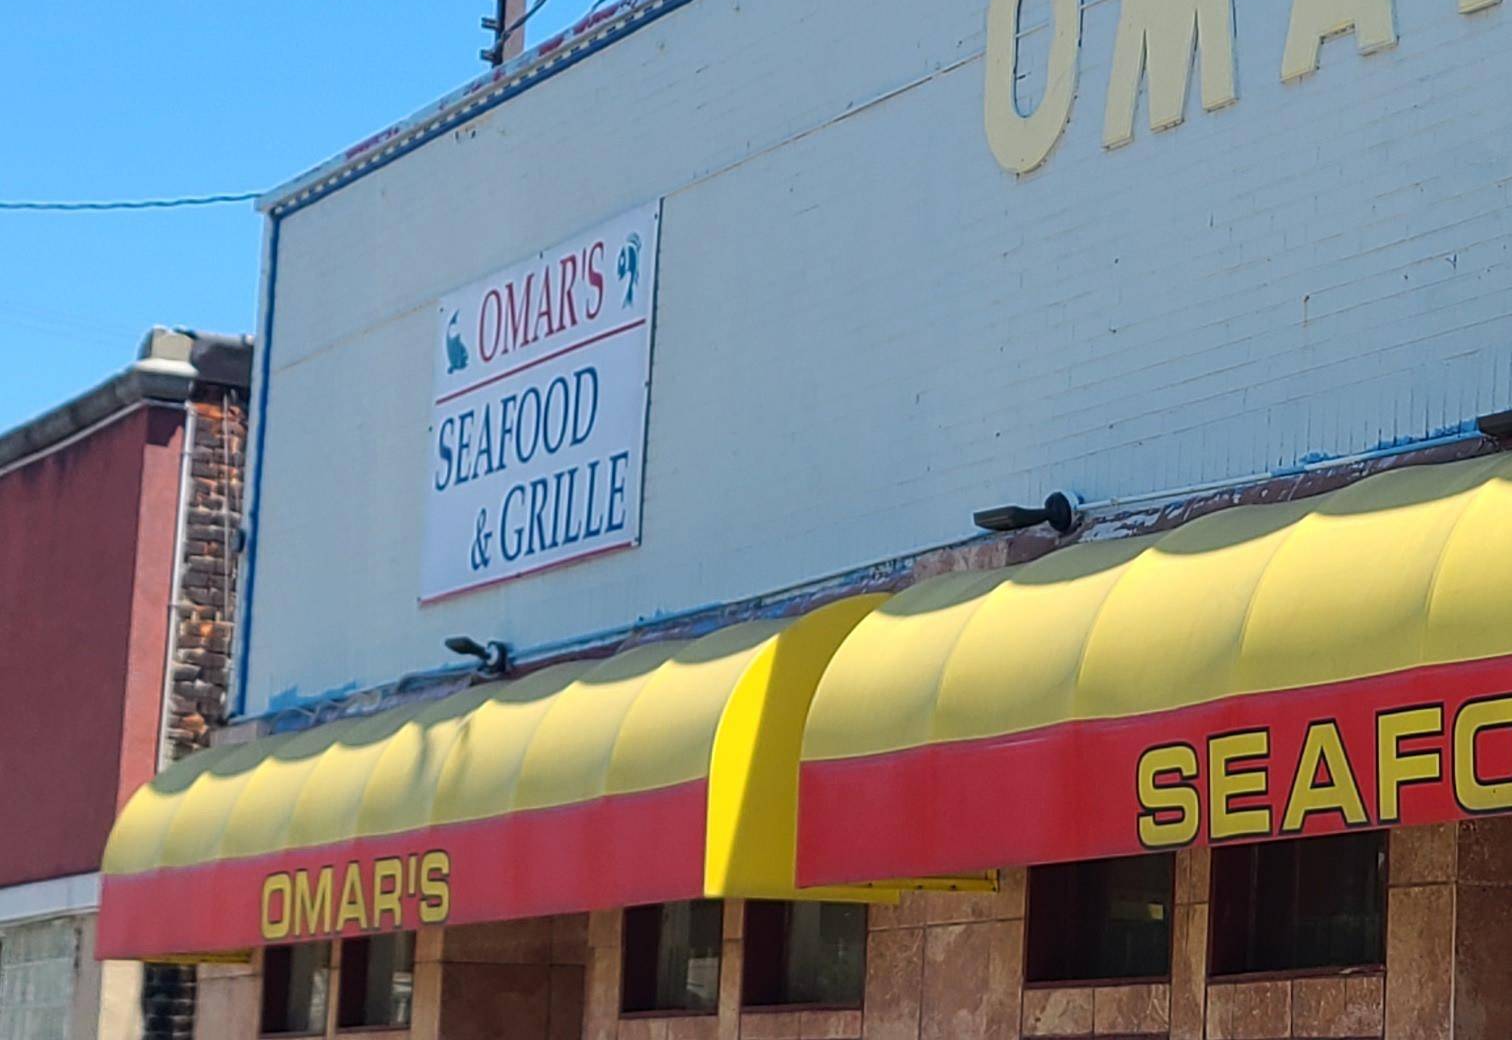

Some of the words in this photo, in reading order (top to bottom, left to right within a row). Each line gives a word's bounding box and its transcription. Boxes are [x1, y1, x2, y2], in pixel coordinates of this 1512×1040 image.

[477, 241, 605, 362] OMAR'S
[435, 366, 599, 492] SEAFOOD
[470, 508, 493, 571] &
[500, 450, 630, 562] GRILLE
[259, 848, 452, 941] OMAR'S
